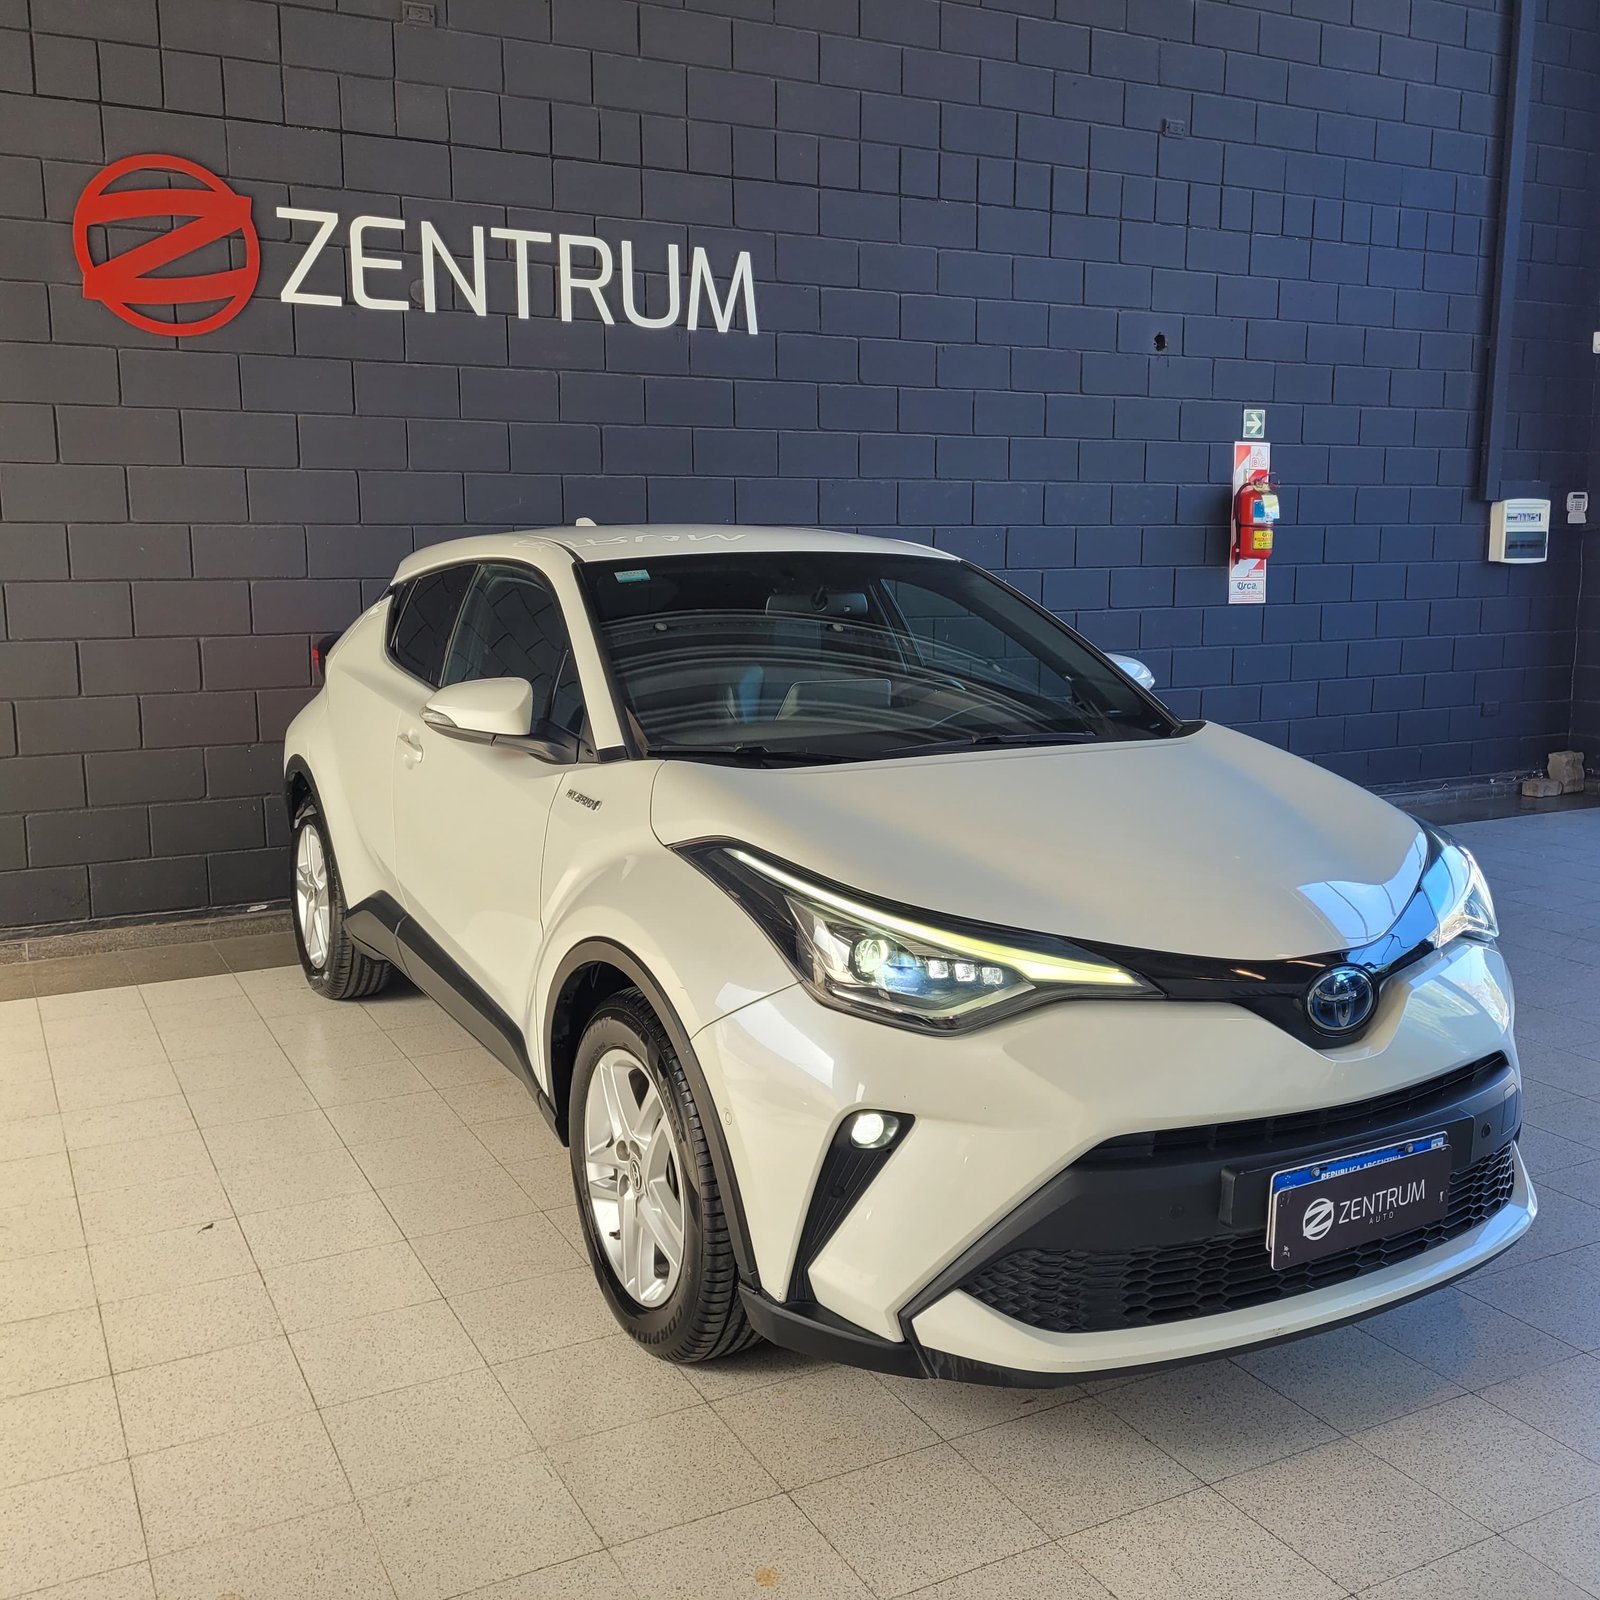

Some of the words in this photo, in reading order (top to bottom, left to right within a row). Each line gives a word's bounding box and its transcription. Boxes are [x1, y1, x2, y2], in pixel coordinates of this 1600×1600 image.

[275, 205, 759, 336] ZENTRUM
[1338, 1179, 1426, 1225] ZENTRUM
[1368, 1211, 1395, 1225] AUTO
